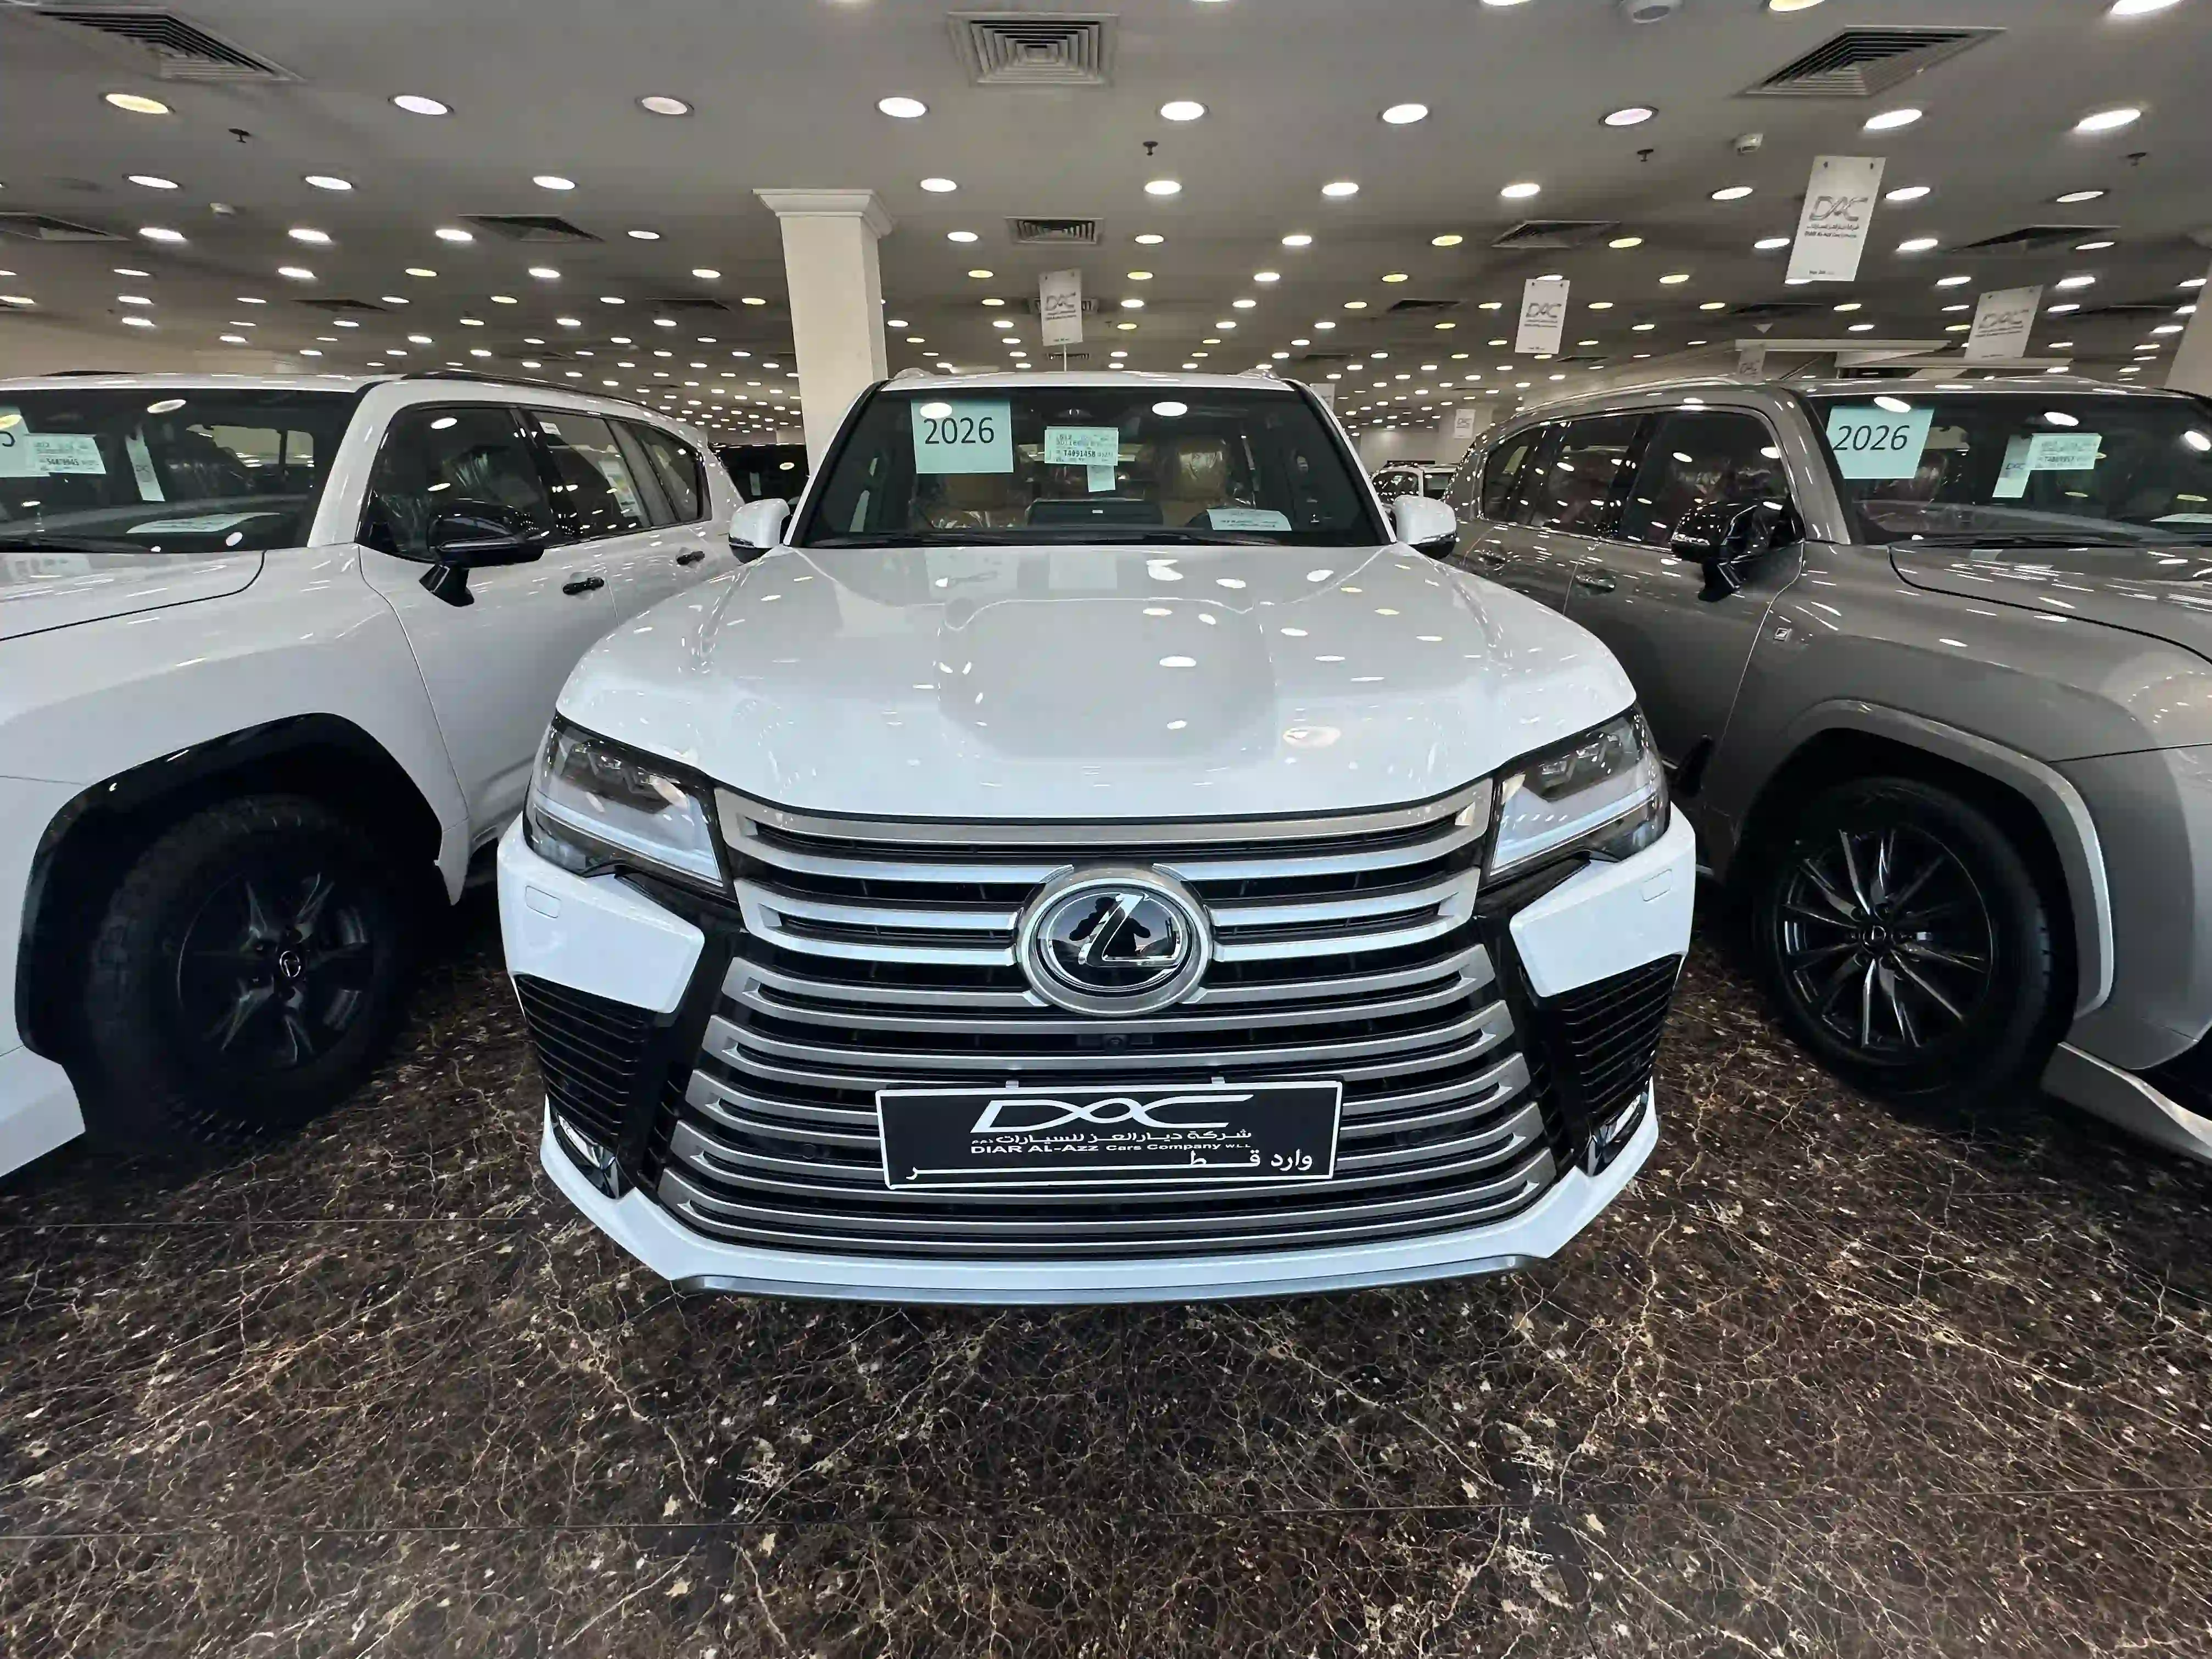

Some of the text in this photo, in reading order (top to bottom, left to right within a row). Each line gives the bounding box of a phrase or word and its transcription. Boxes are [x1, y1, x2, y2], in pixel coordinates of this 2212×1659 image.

[923, 416, 995, 445] 2026
[1833, 424, 1911, 451] 2026
[996, 1133, 1085, 1145] للسيارات
[1187, 1129, 1252, 1141] شركة
[971, 1145, 1023, 1154] DIAR
[1271, 1149, 1313, 1171] وارد
